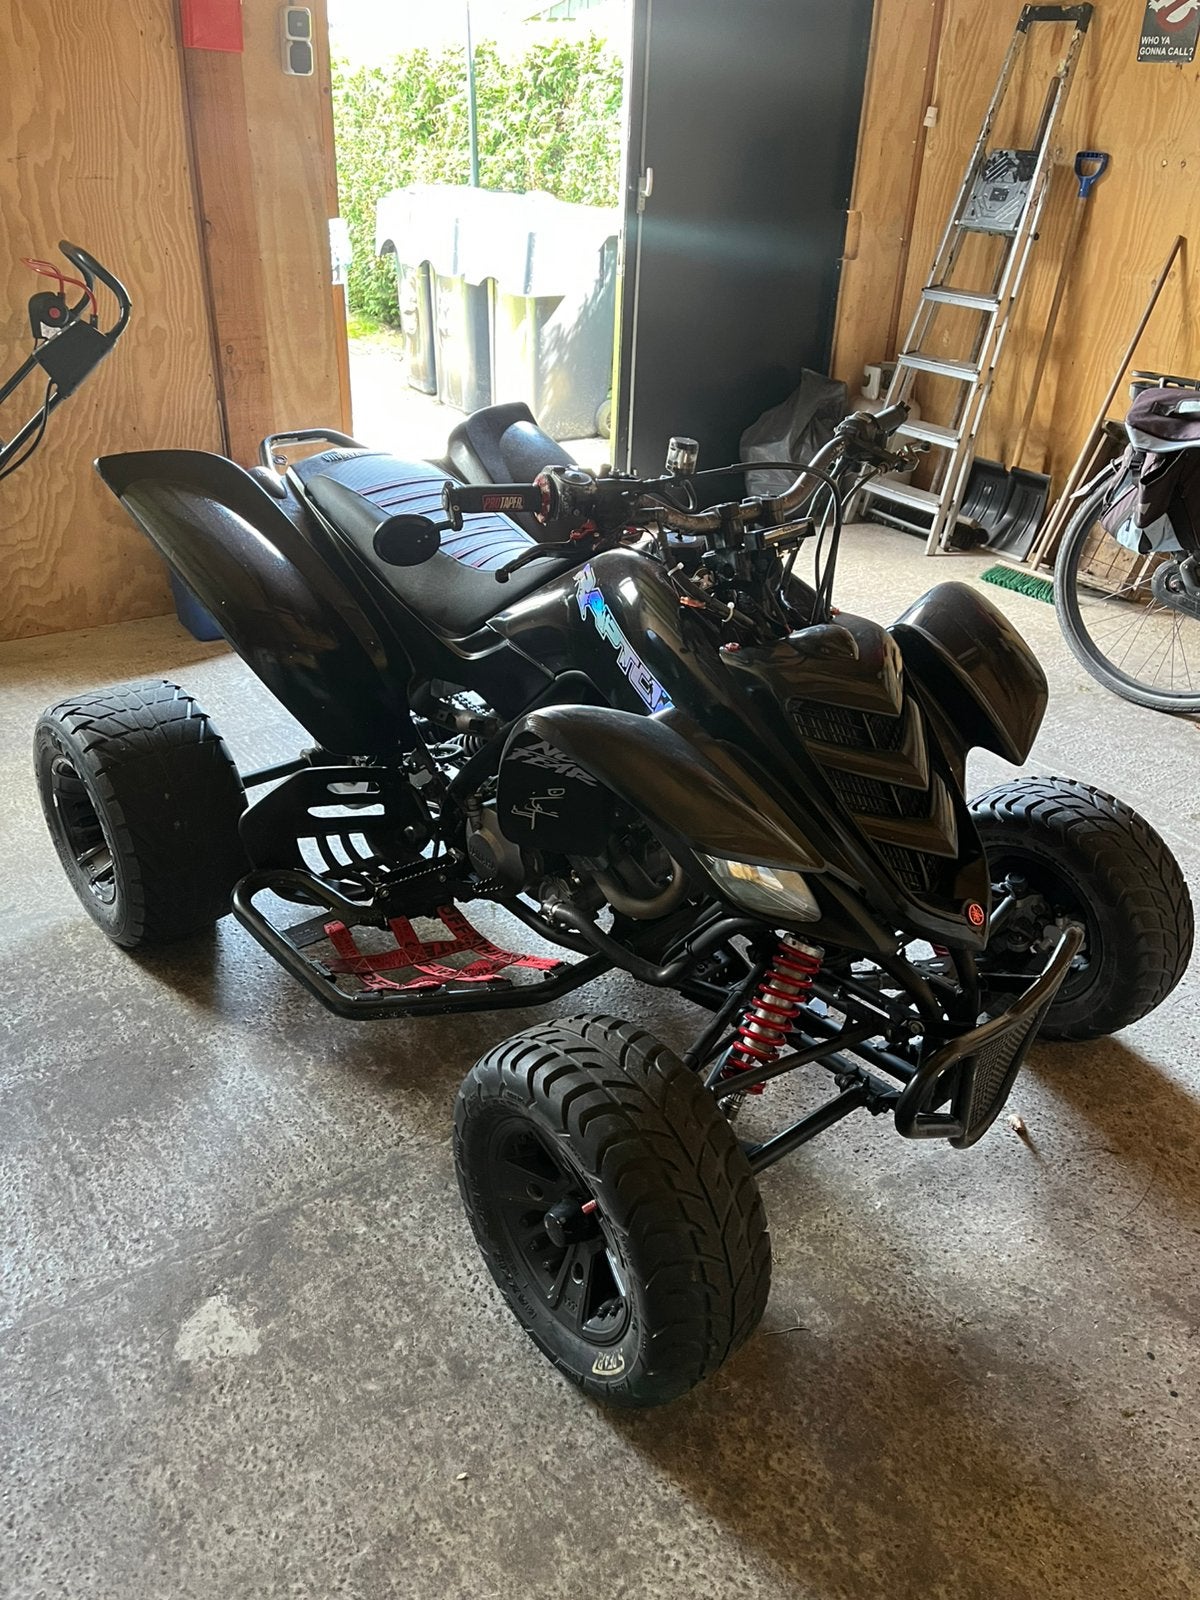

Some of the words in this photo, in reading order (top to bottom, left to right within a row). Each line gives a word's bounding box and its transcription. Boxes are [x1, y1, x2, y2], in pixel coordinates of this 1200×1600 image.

[1141, 36, 1160, 45] WHO
[1161, 36, 1171, 45] YA
[1139, 47, 1166, 56] GONNA
[1167, 47, 1194, 56] CALL?
[505, 748, 598, 787] FEAR
